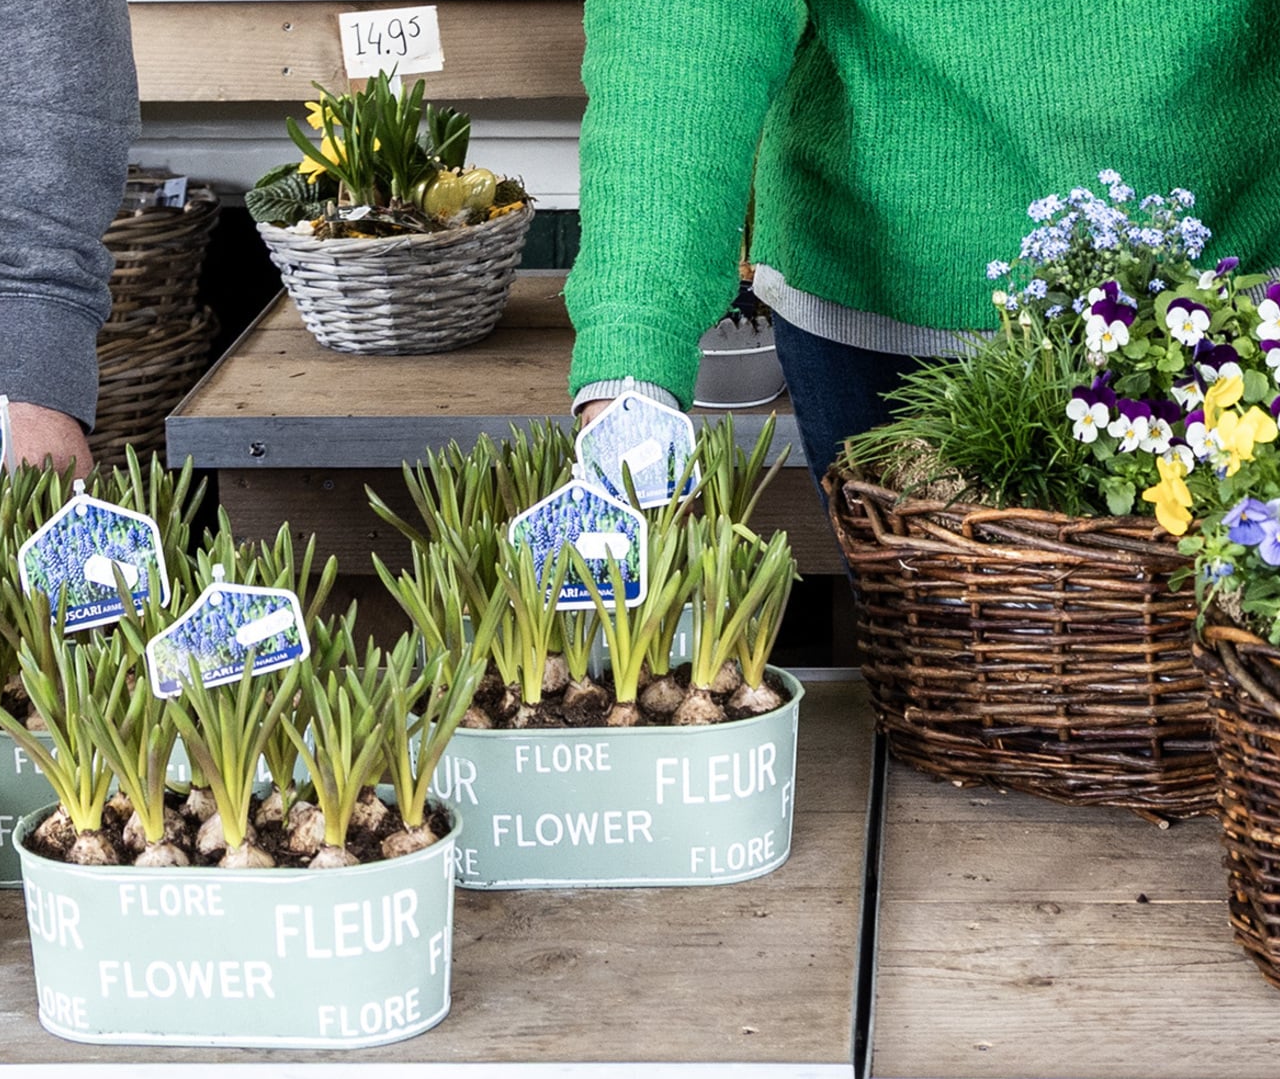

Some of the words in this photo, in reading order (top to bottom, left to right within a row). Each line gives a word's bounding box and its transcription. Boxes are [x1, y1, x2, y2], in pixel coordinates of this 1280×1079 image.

[350, 15, 421, 56] 14.95
[515, 742, 611, 774] FLORE
[655, 741, 777, 805] FLEUR
[493, 810, 654, 848] FLOWER
[690, 830, 775, 873] FLORE
[119, 883, 225, 917] FLORE
[275, 887, 420, 959] FLEUR
[98, 960, 275, 999] FLOWER
[318, 987, 421, 1037] FLORE
